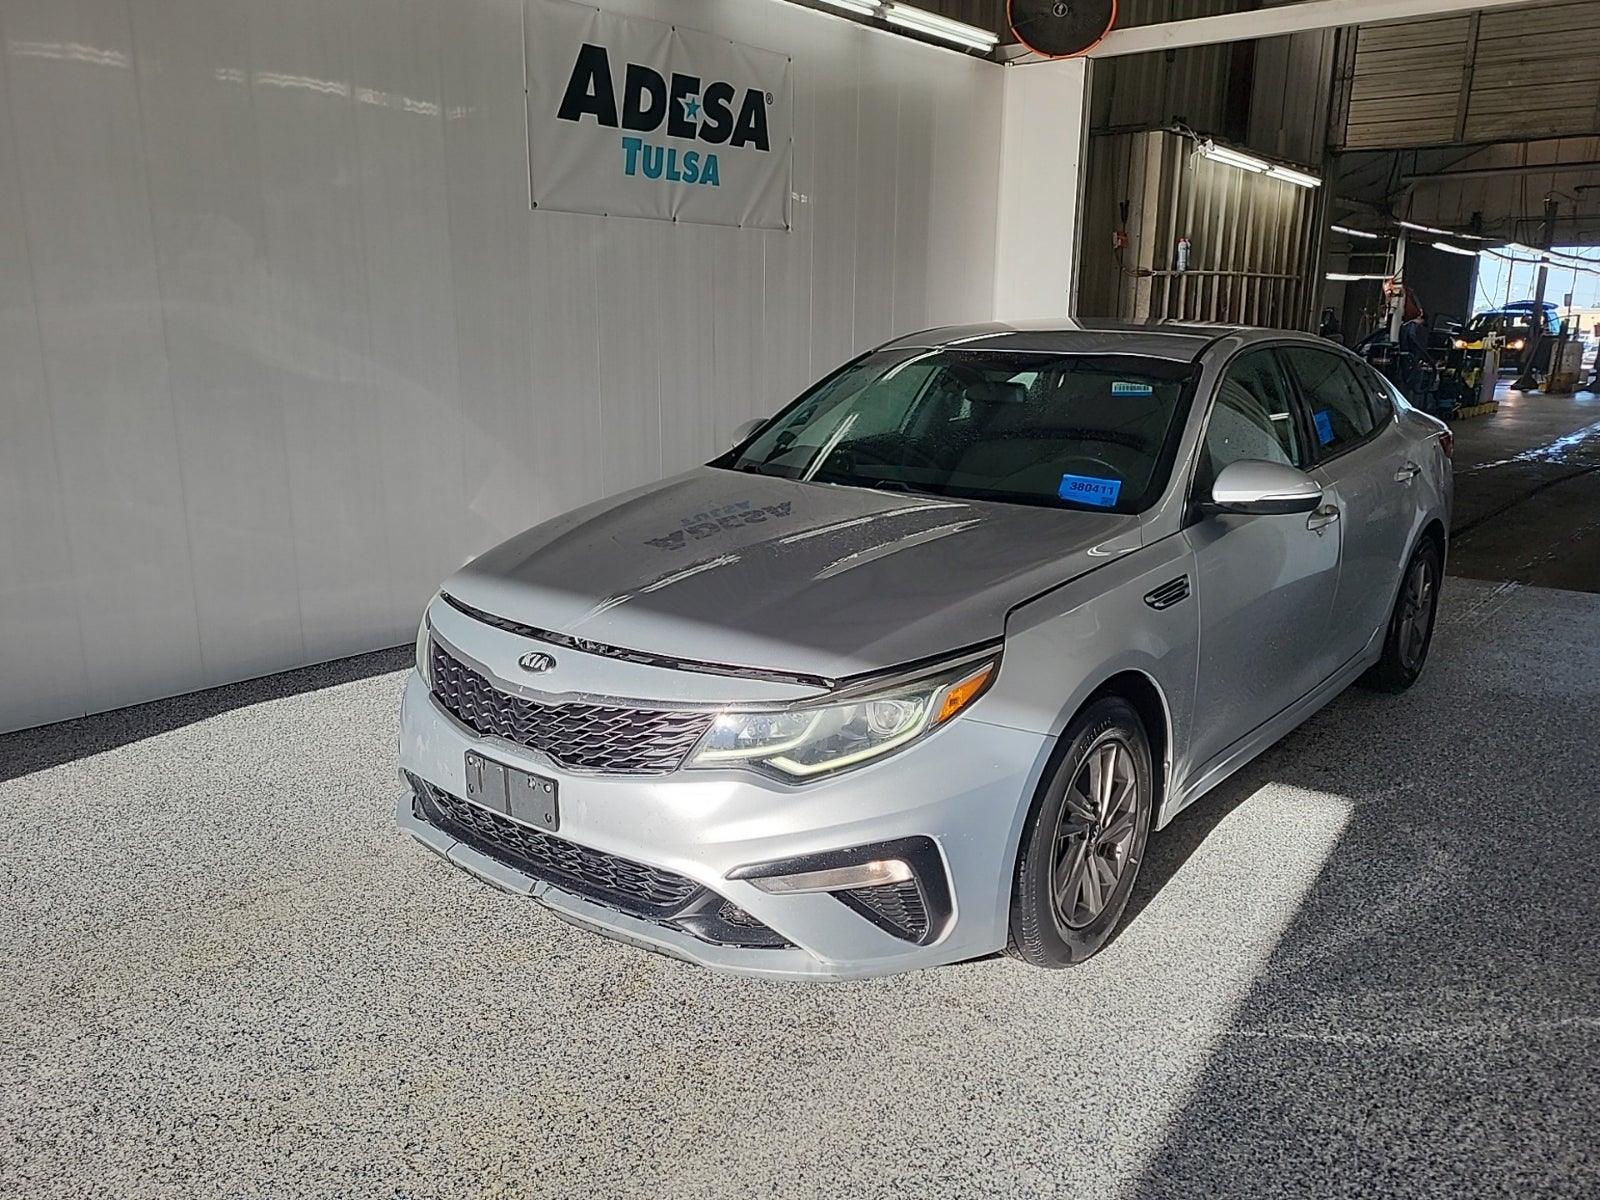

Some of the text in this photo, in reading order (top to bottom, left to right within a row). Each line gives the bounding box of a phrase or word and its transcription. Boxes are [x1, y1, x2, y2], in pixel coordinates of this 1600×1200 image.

[556, 43, 771, 152] ADESA
[621, 136, 721, 187] TULSA
[1069, 481, 1115, 496] 380411
[520, 653, 550, 671] KIA
